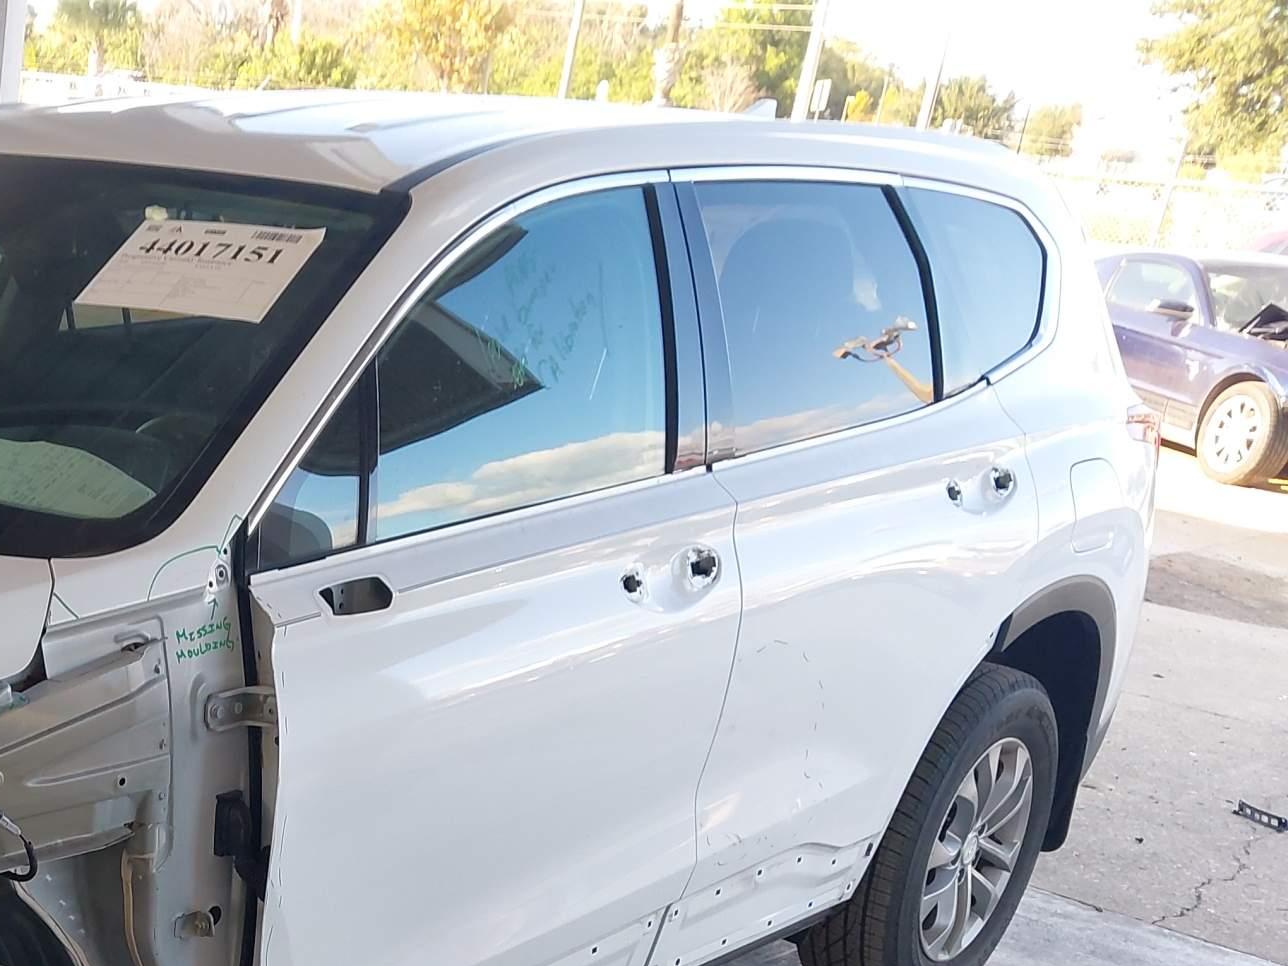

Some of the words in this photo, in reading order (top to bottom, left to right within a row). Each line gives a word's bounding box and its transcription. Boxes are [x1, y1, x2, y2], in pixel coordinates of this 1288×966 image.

[138, 237, 285, 265] 44017151
[175, 616, 232, 645] MISSING
[175, 639, 235, 665] MOULDING
